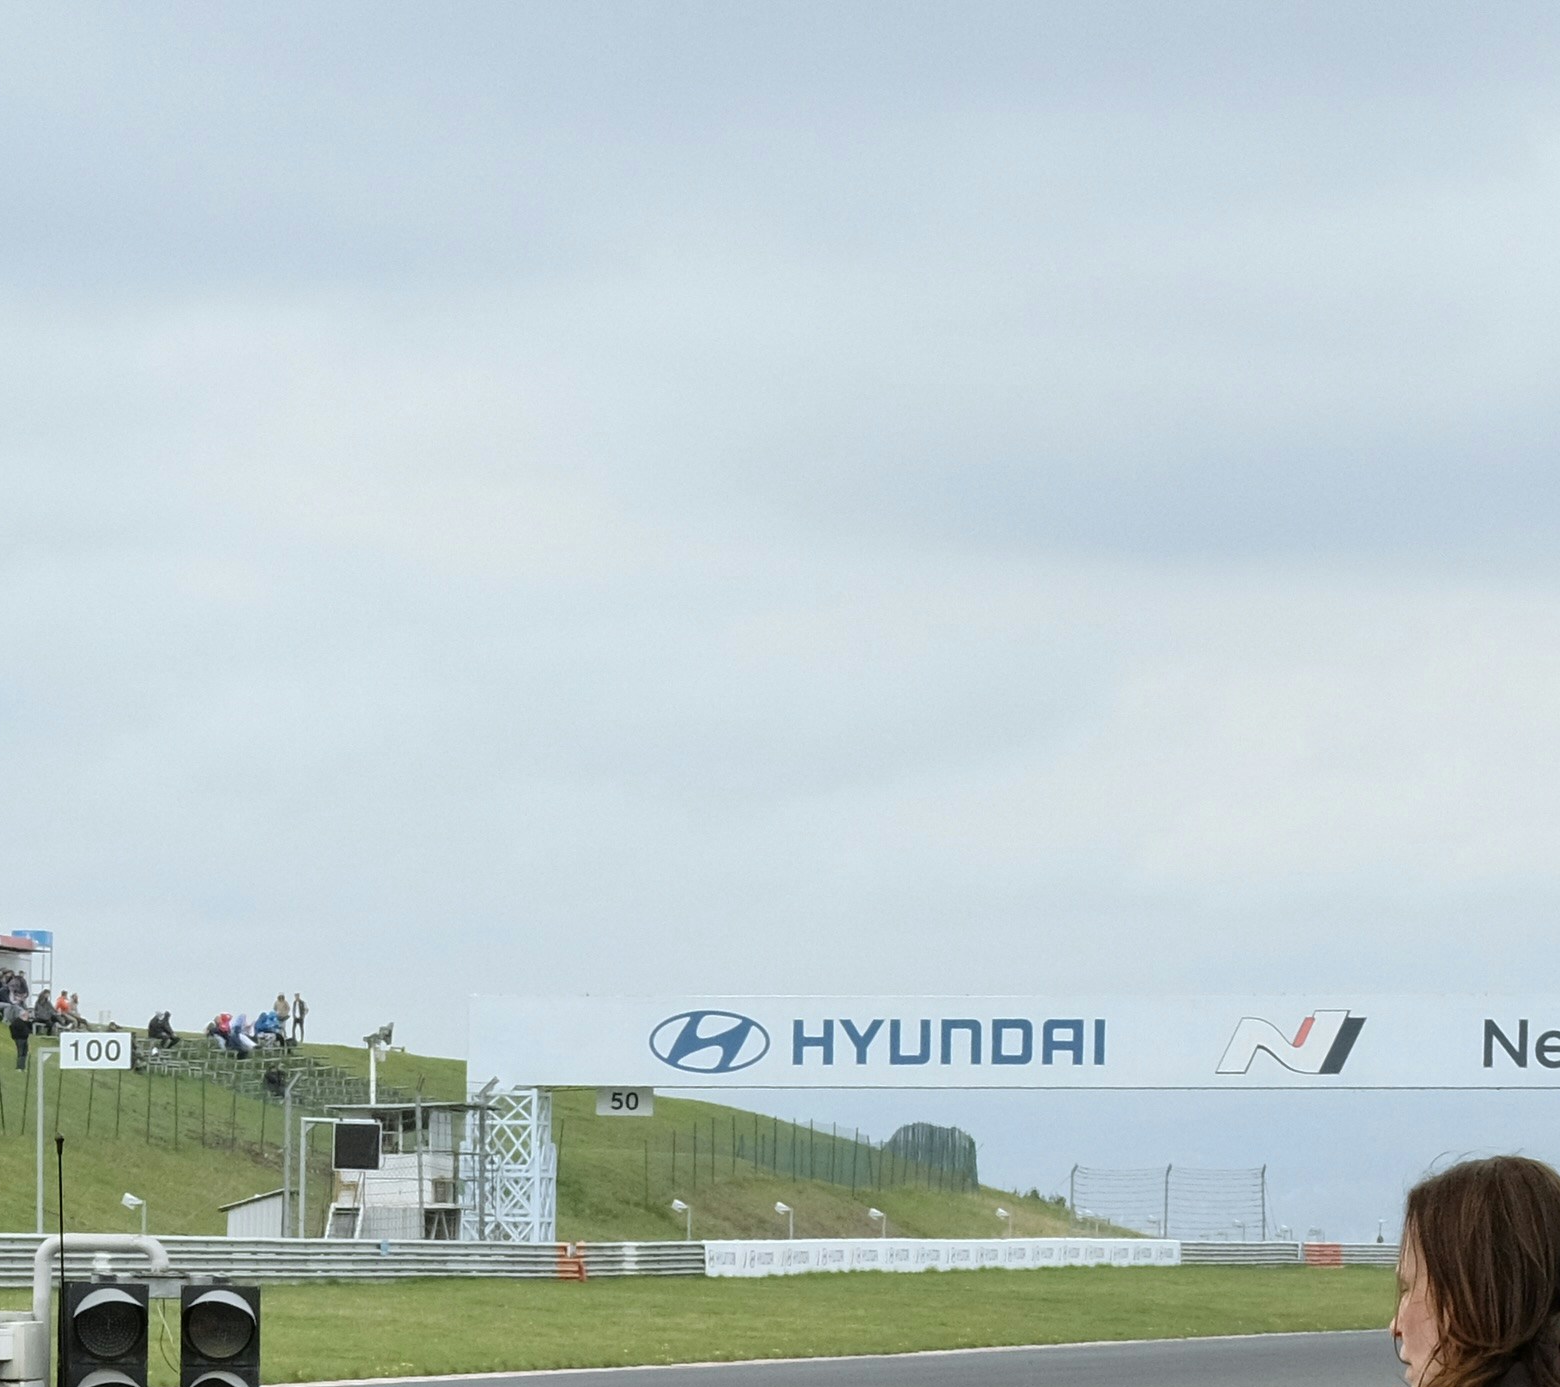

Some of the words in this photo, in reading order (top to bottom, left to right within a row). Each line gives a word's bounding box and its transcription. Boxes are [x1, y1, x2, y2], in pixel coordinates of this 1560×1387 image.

[69, 1039, 121, 1062] 100
[791, 1018, 1106, 1066] HYUNDAI
[611, 1091, 640, 1111] 50
